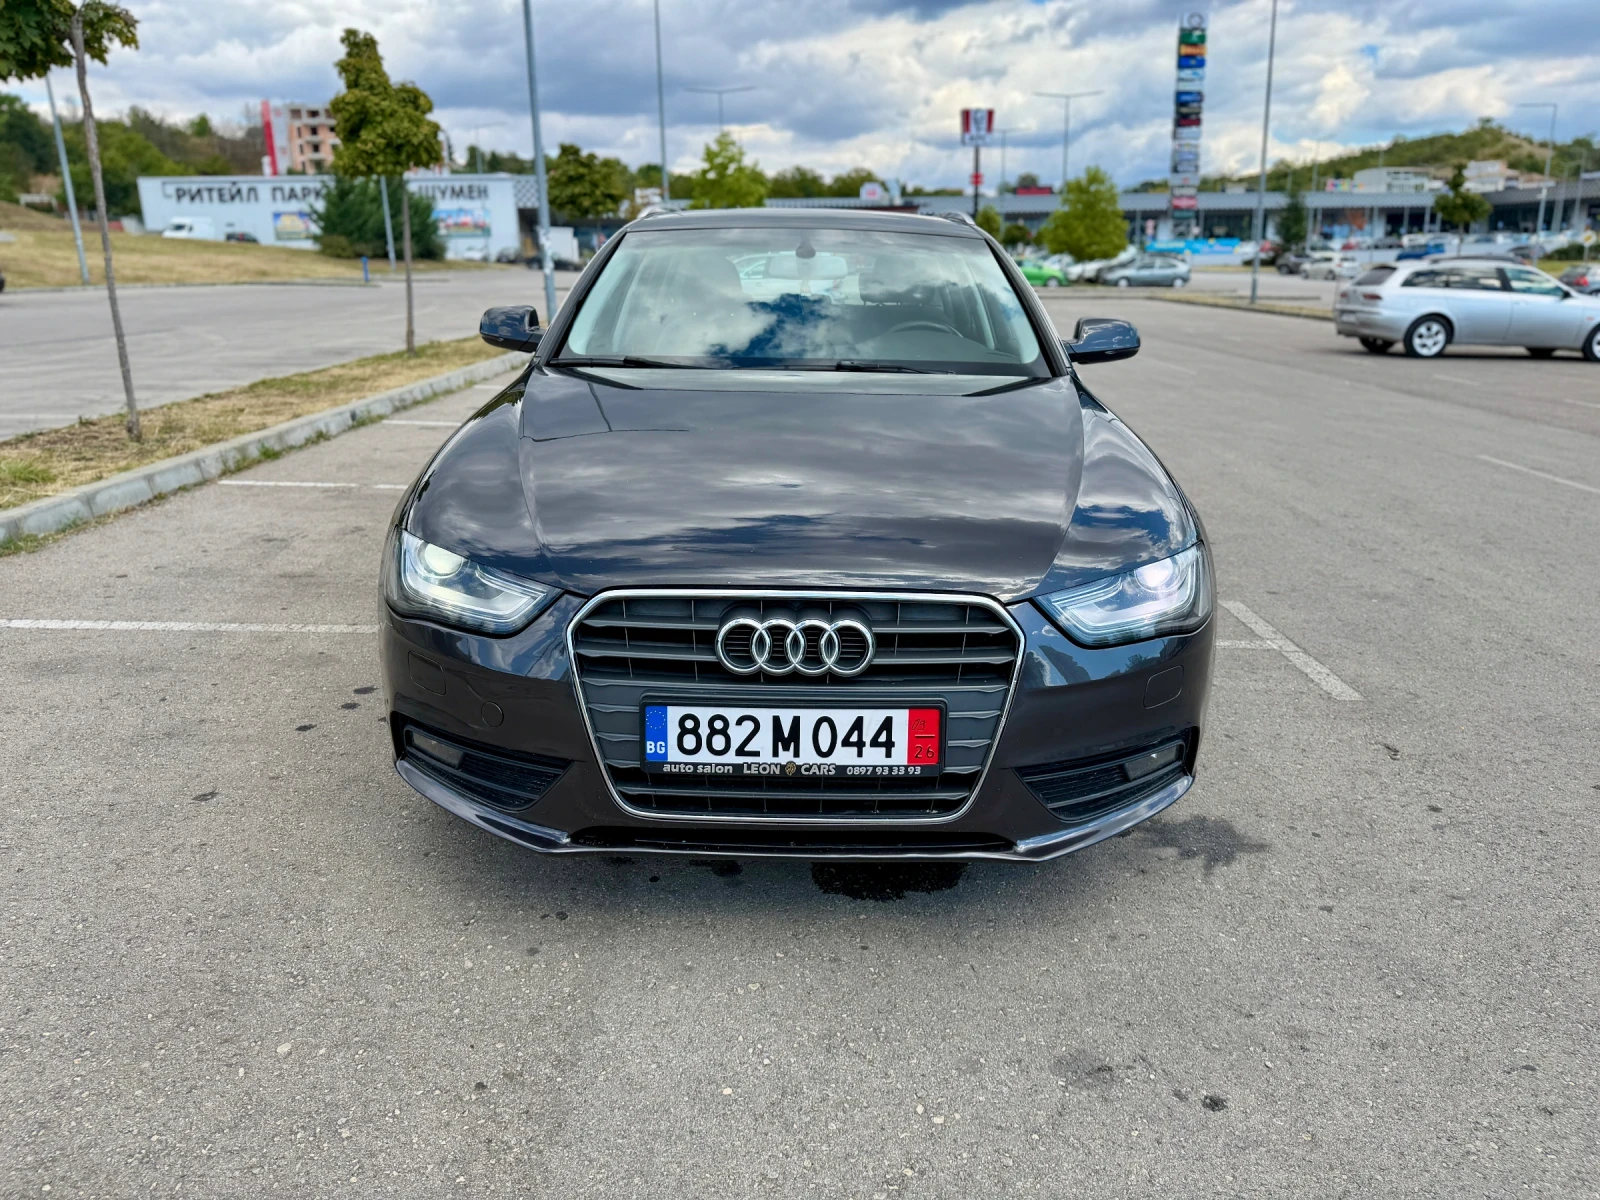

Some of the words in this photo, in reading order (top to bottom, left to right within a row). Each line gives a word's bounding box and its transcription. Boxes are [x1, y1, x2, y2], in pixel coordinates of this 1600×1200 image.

[175, 181, 259, 203] РИТЕЙЛ
[272, 186, 324, 203] ПАРК
[676, 713, 761, 757] 882
[772, 715, 801, 758] M
[812, 716, 895, 759] 044
[646, 741, 666, 754] BG
[915, 744, 935, 758] 26
[662, 763, 694, 773] auto
[696, 764, 733, 774] salon
[743, 763, 781, 775] LEON
[801, 764, 836, 775] CARS
[846, 766, 873, 775] 0897
[875, 766, 889, 775] 93
[891, 766, 905, 775] 33
[907, 766, 921, 775] 93
